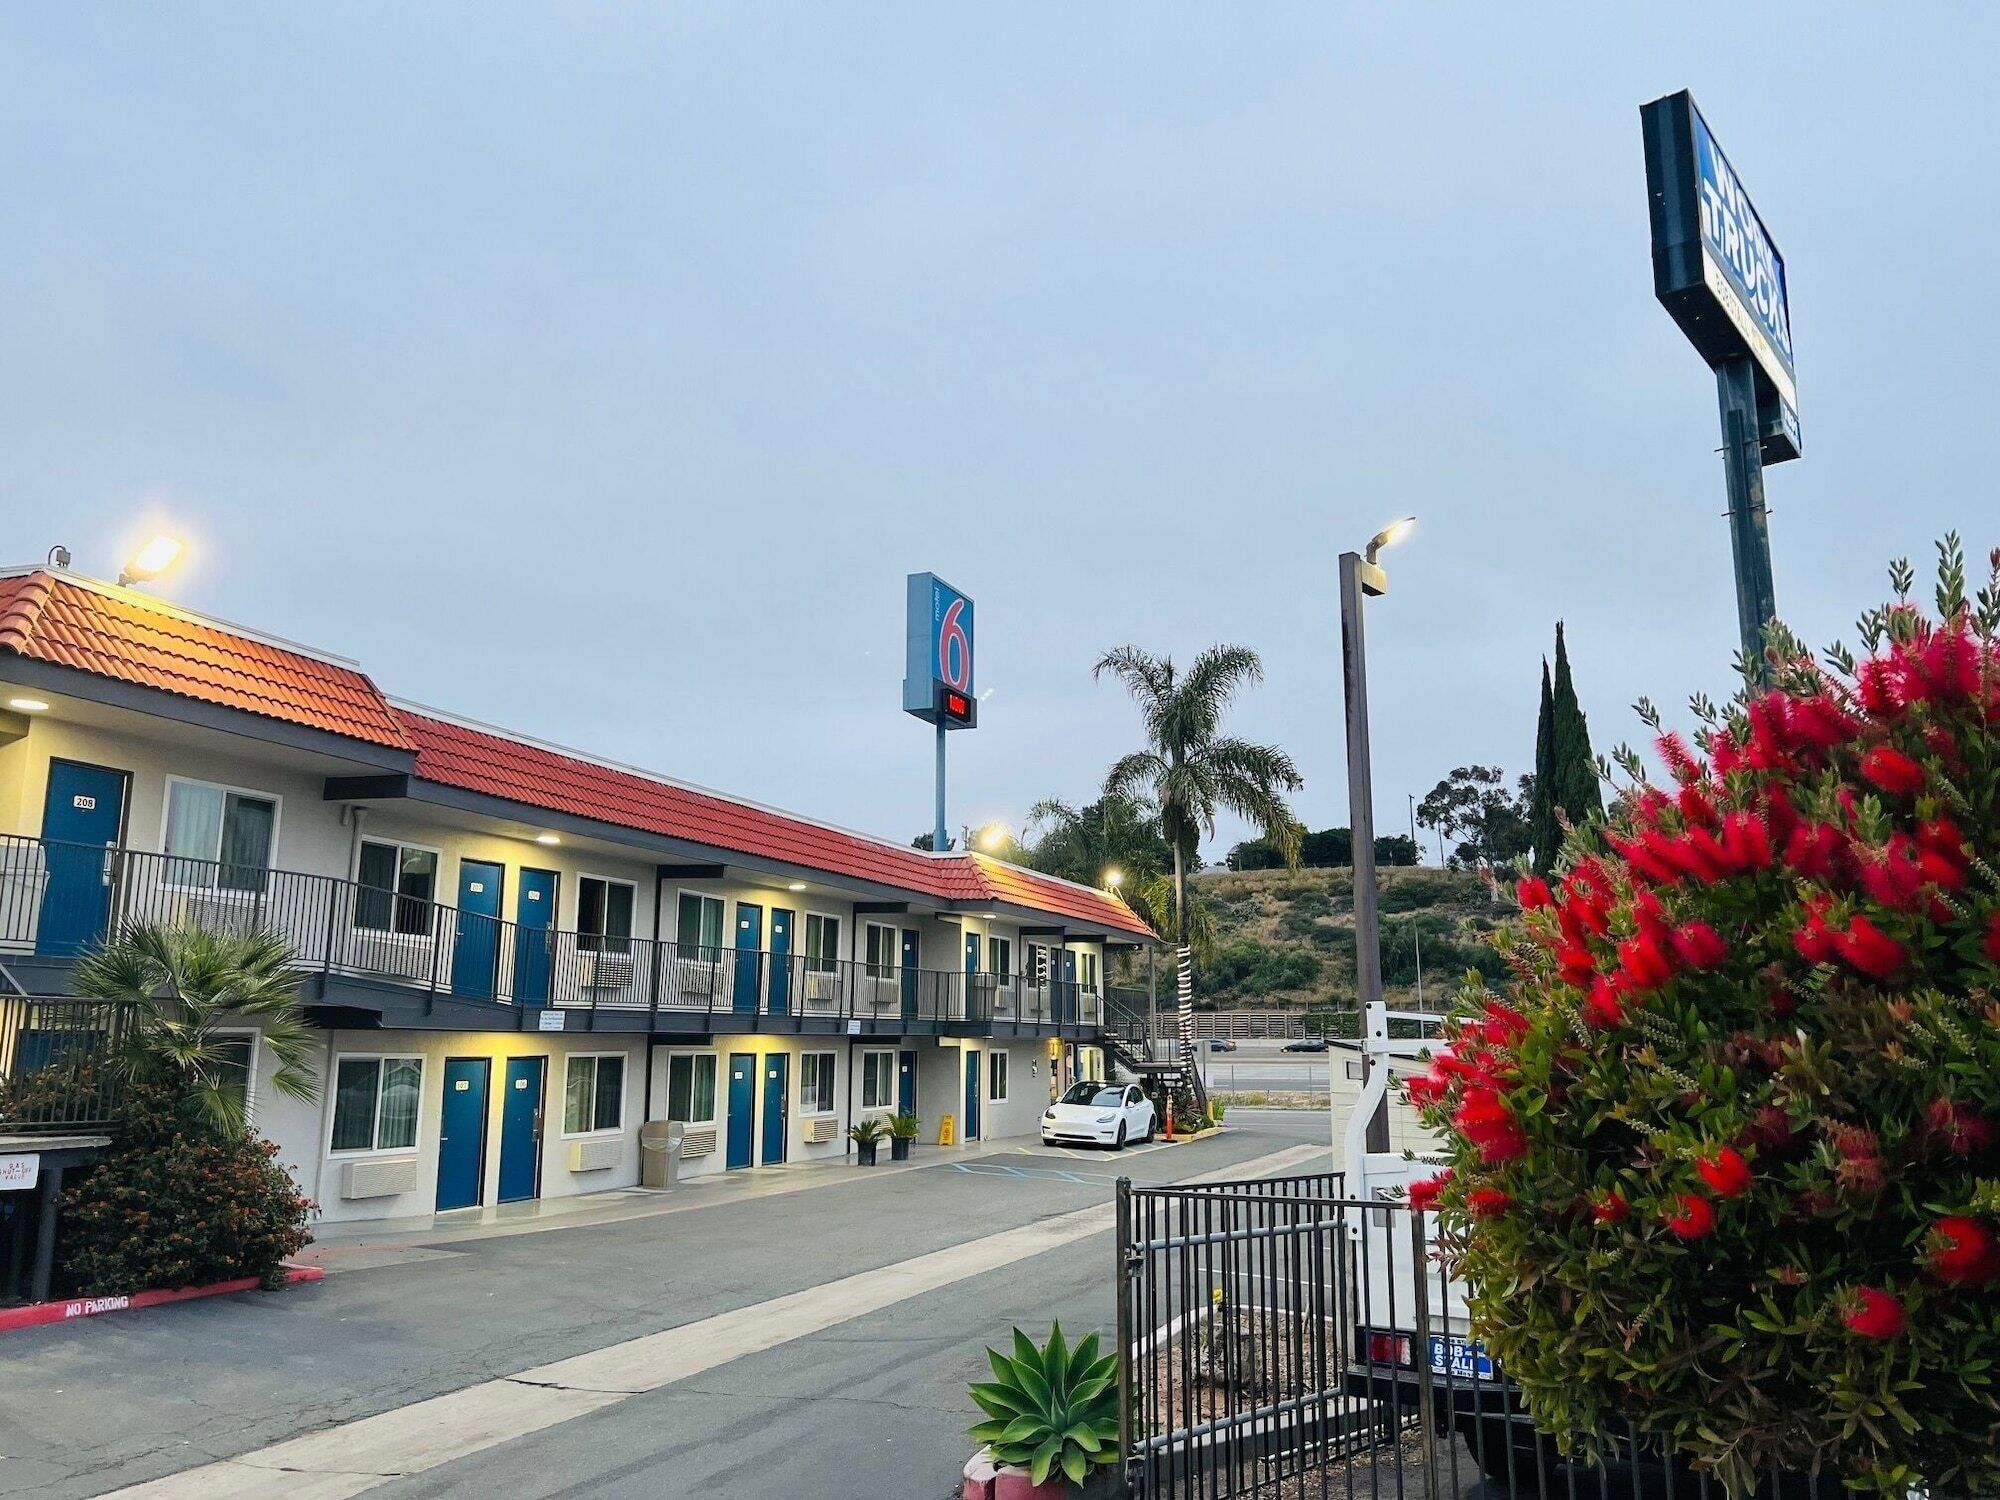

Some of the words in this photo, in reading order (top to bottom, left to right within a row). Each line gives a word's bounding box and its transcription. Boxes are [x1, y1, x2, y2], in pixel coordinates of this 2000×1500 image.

[939, 598, 969, 693] 6
[66, 1303, 82, 1317] NO
[85, 1296, 129, 1314] PARKING
